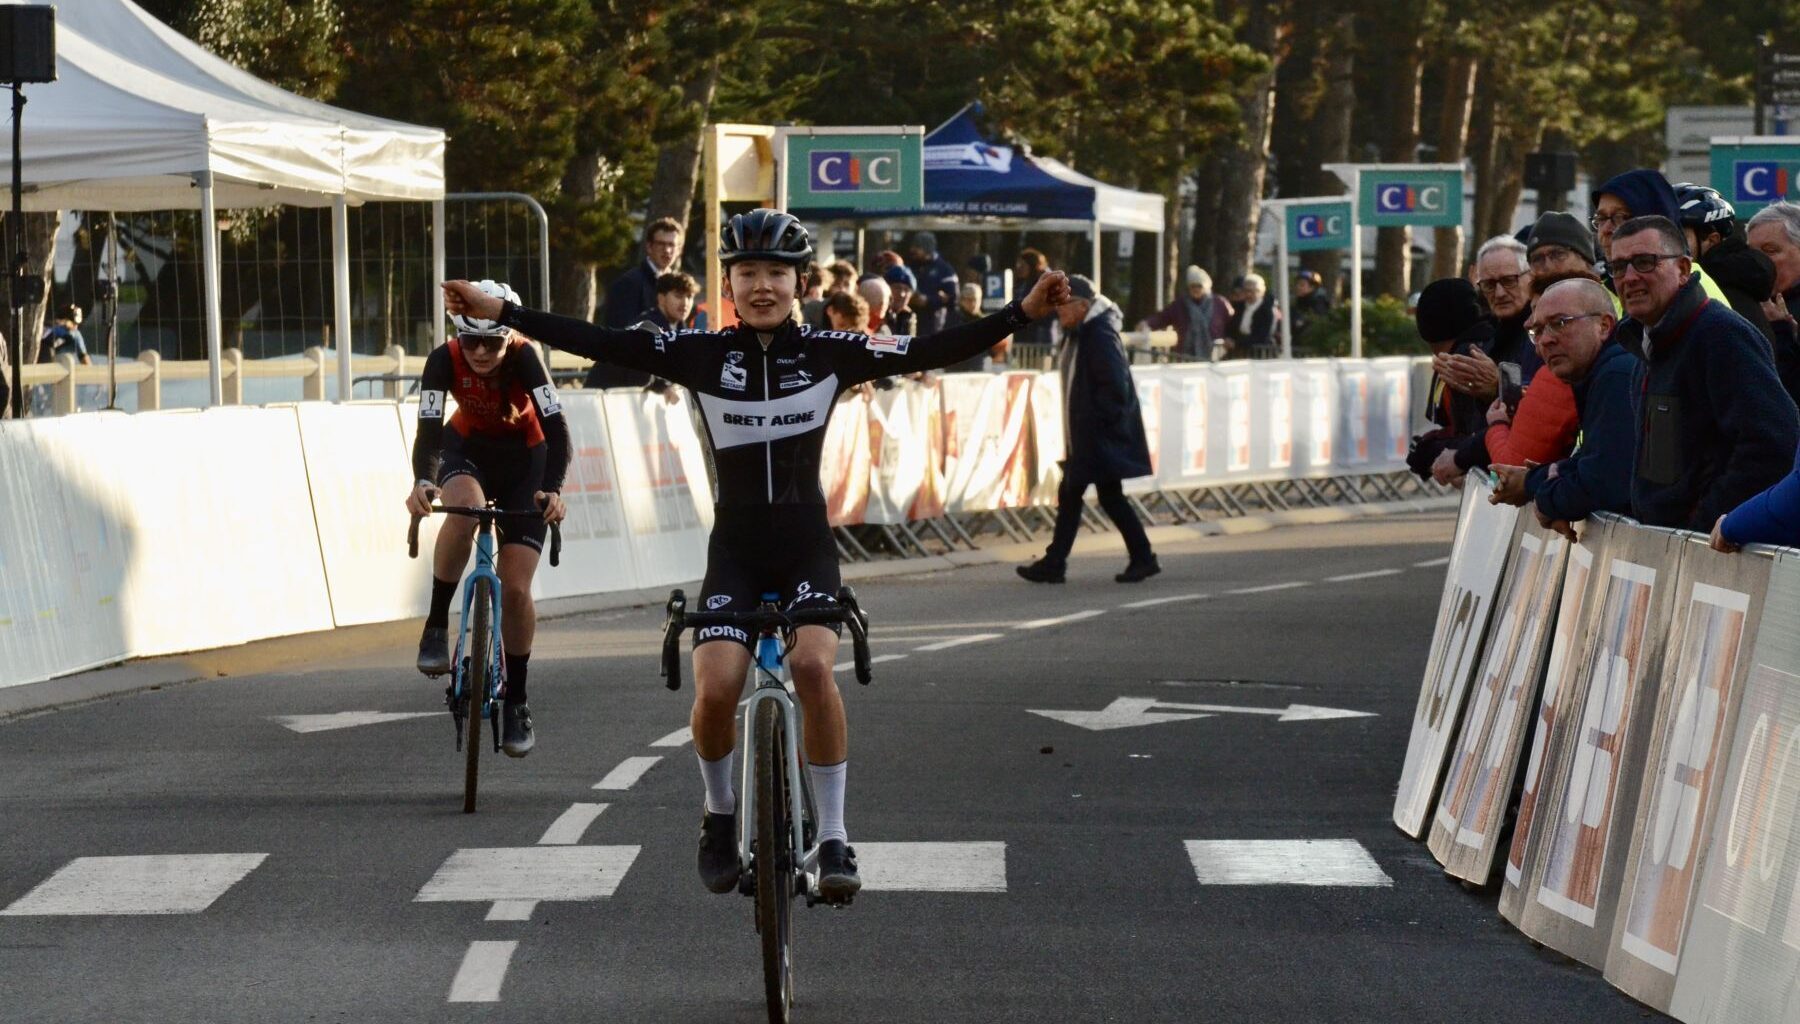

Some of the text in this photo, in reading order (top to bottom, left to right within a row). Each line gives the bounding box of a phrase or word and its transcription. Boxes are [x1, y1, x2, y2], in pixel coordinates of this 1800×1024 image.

[818, 157, 892, 186] CIC
[1743, 167, 1800, 196] CI
[1381, 187, 1440, 210] CIC
[1300, 215, 1342, 237] CIC
